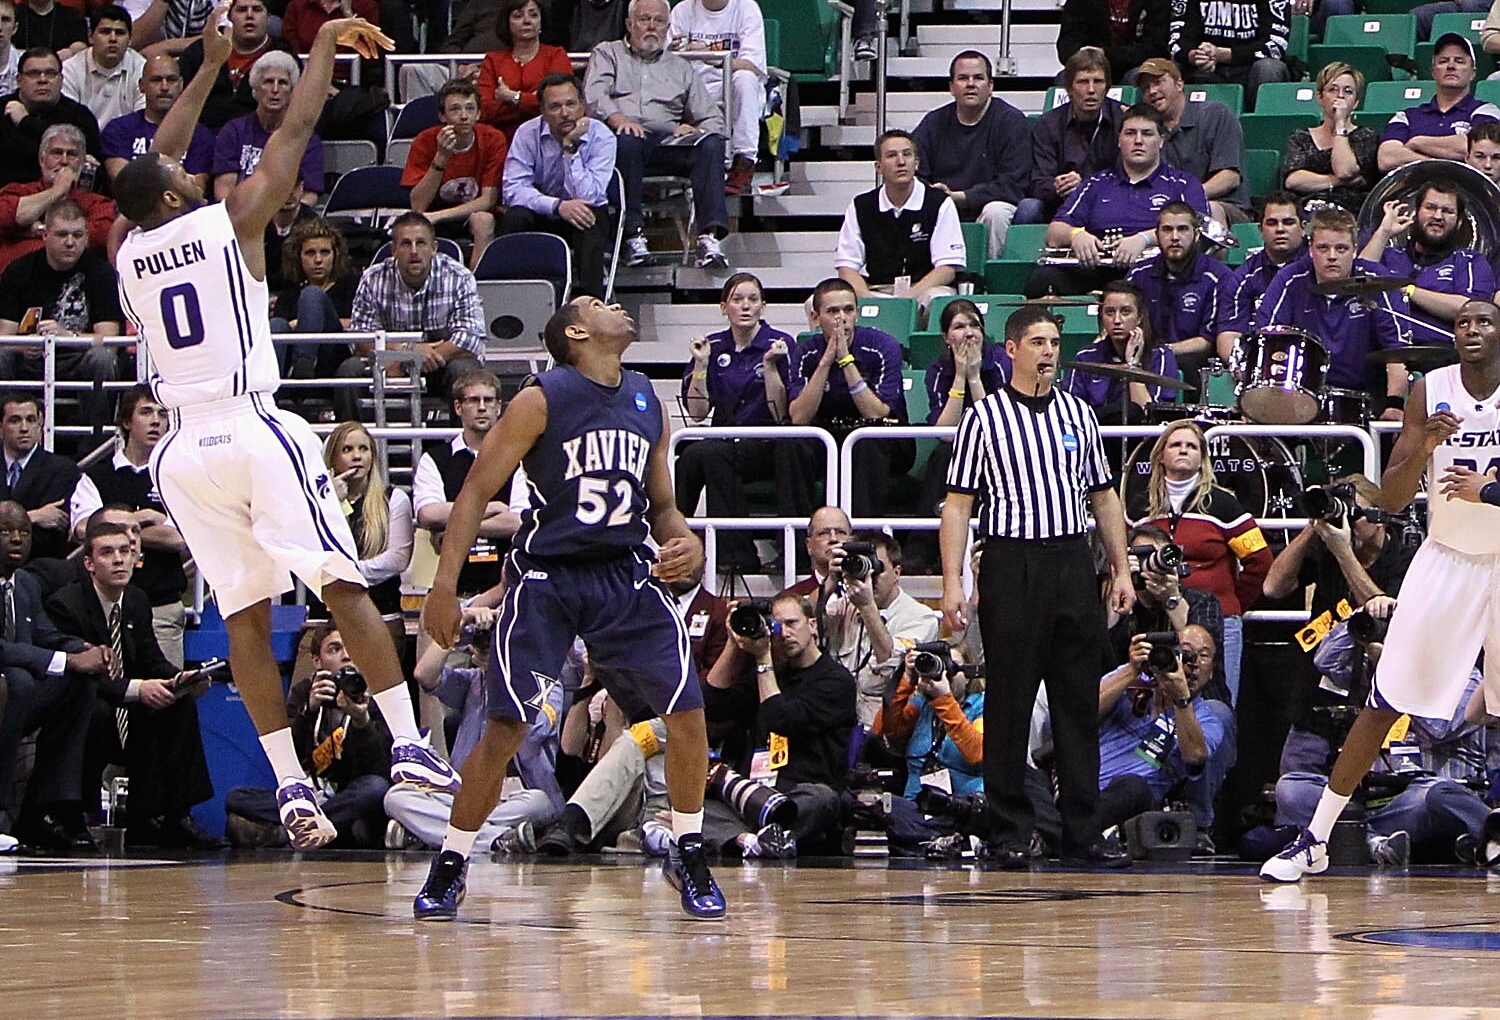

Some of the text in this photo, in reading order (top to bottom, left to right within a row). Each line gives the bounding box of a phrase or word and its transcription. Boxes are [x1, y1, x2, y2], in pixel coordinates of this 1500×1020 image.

[1200, 0, 1260, 30] FAMOUS
[133, 240, 206, 280] PULLEN
[160, 282, 206, 349] 0
[199, 434, 232, 448] WILDCATS
[562, 428, 650, 488] XAVIER
[575, 476, 634, 529] 52
